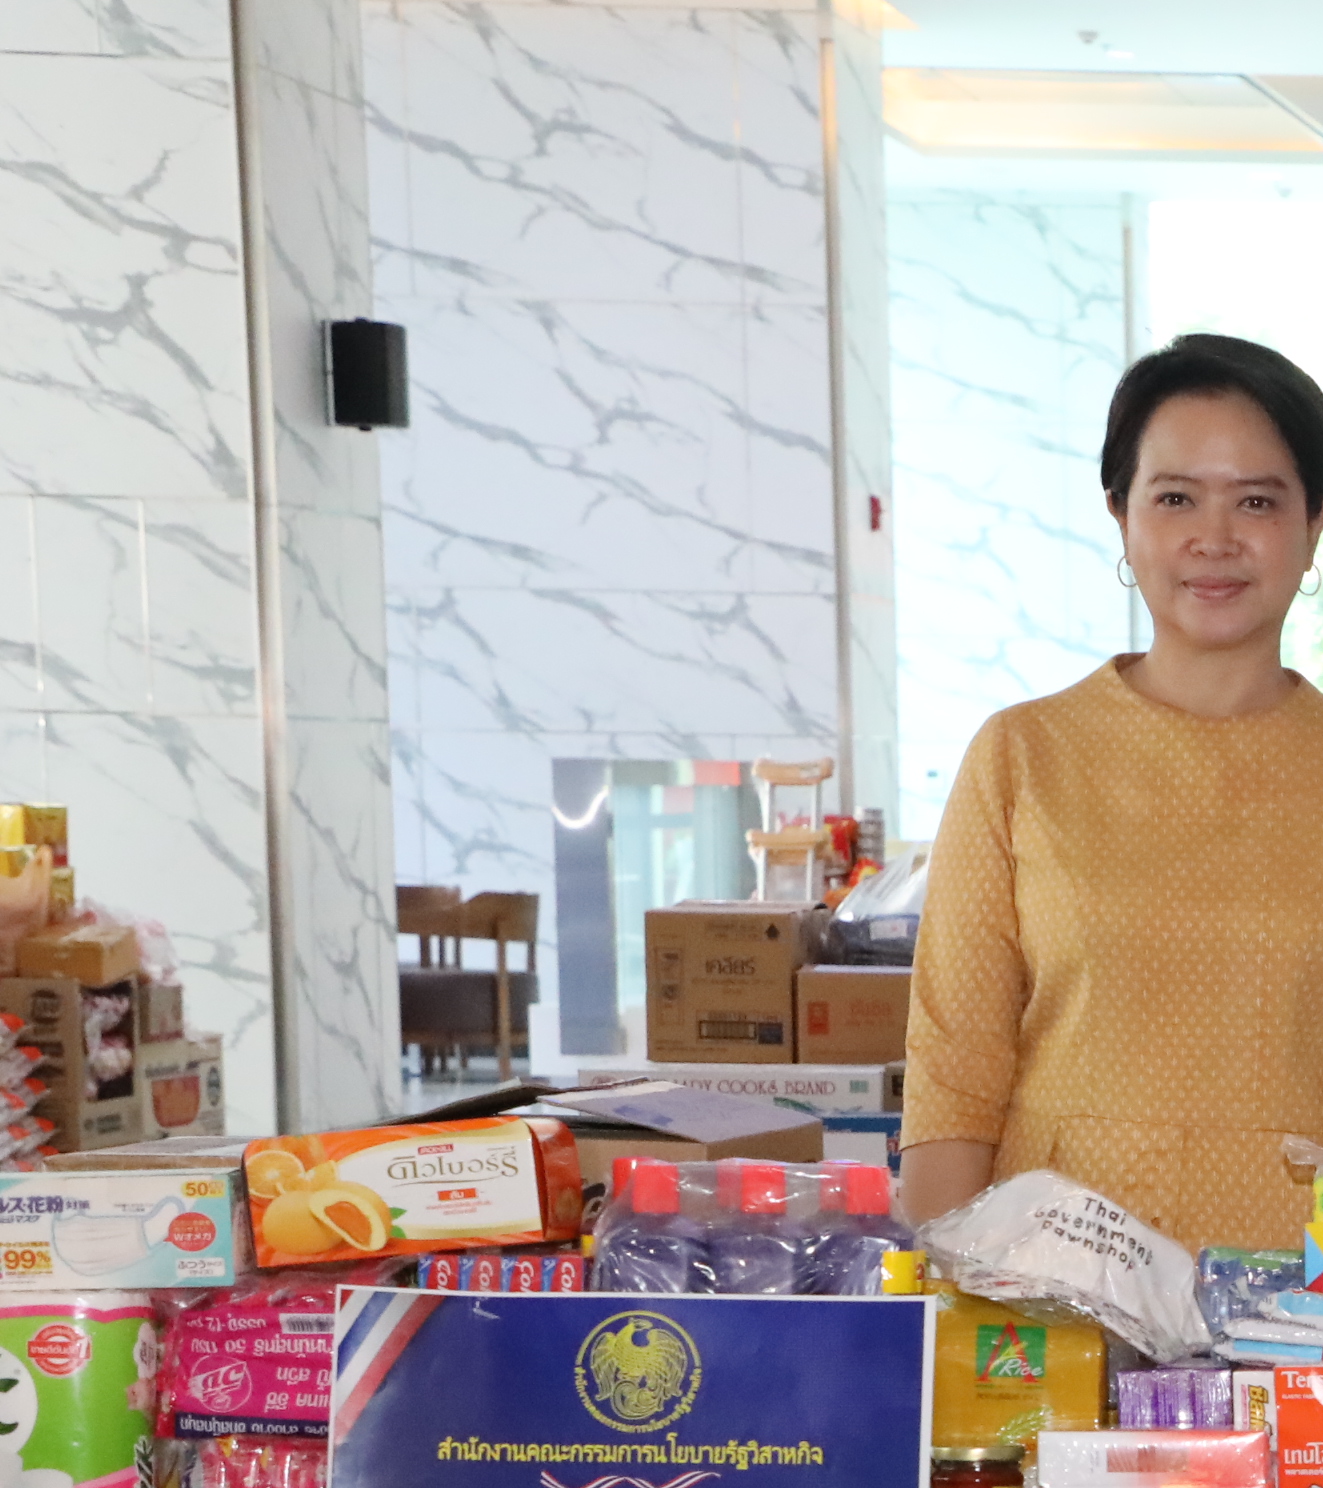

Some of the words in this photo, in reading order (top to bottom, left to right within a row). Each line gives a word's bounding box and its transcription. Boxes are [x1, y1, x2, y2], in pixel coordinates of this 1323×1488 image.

[718, 1080, 778, 1095] COOKS
[784, 1080, 836, 1096] BRAND
[1085, 1197, 1127, 1226] Thai
[1035, 1209, 1153, 1266] Government
[1042, 1221, 1136, 1273] Pawnshop
[994, 1359, 1044, 1377] Rice
[437, 1432, 823, 1470] สำนักงานคณะกรรมการนโยบายรัฐวิสาหกิจ
